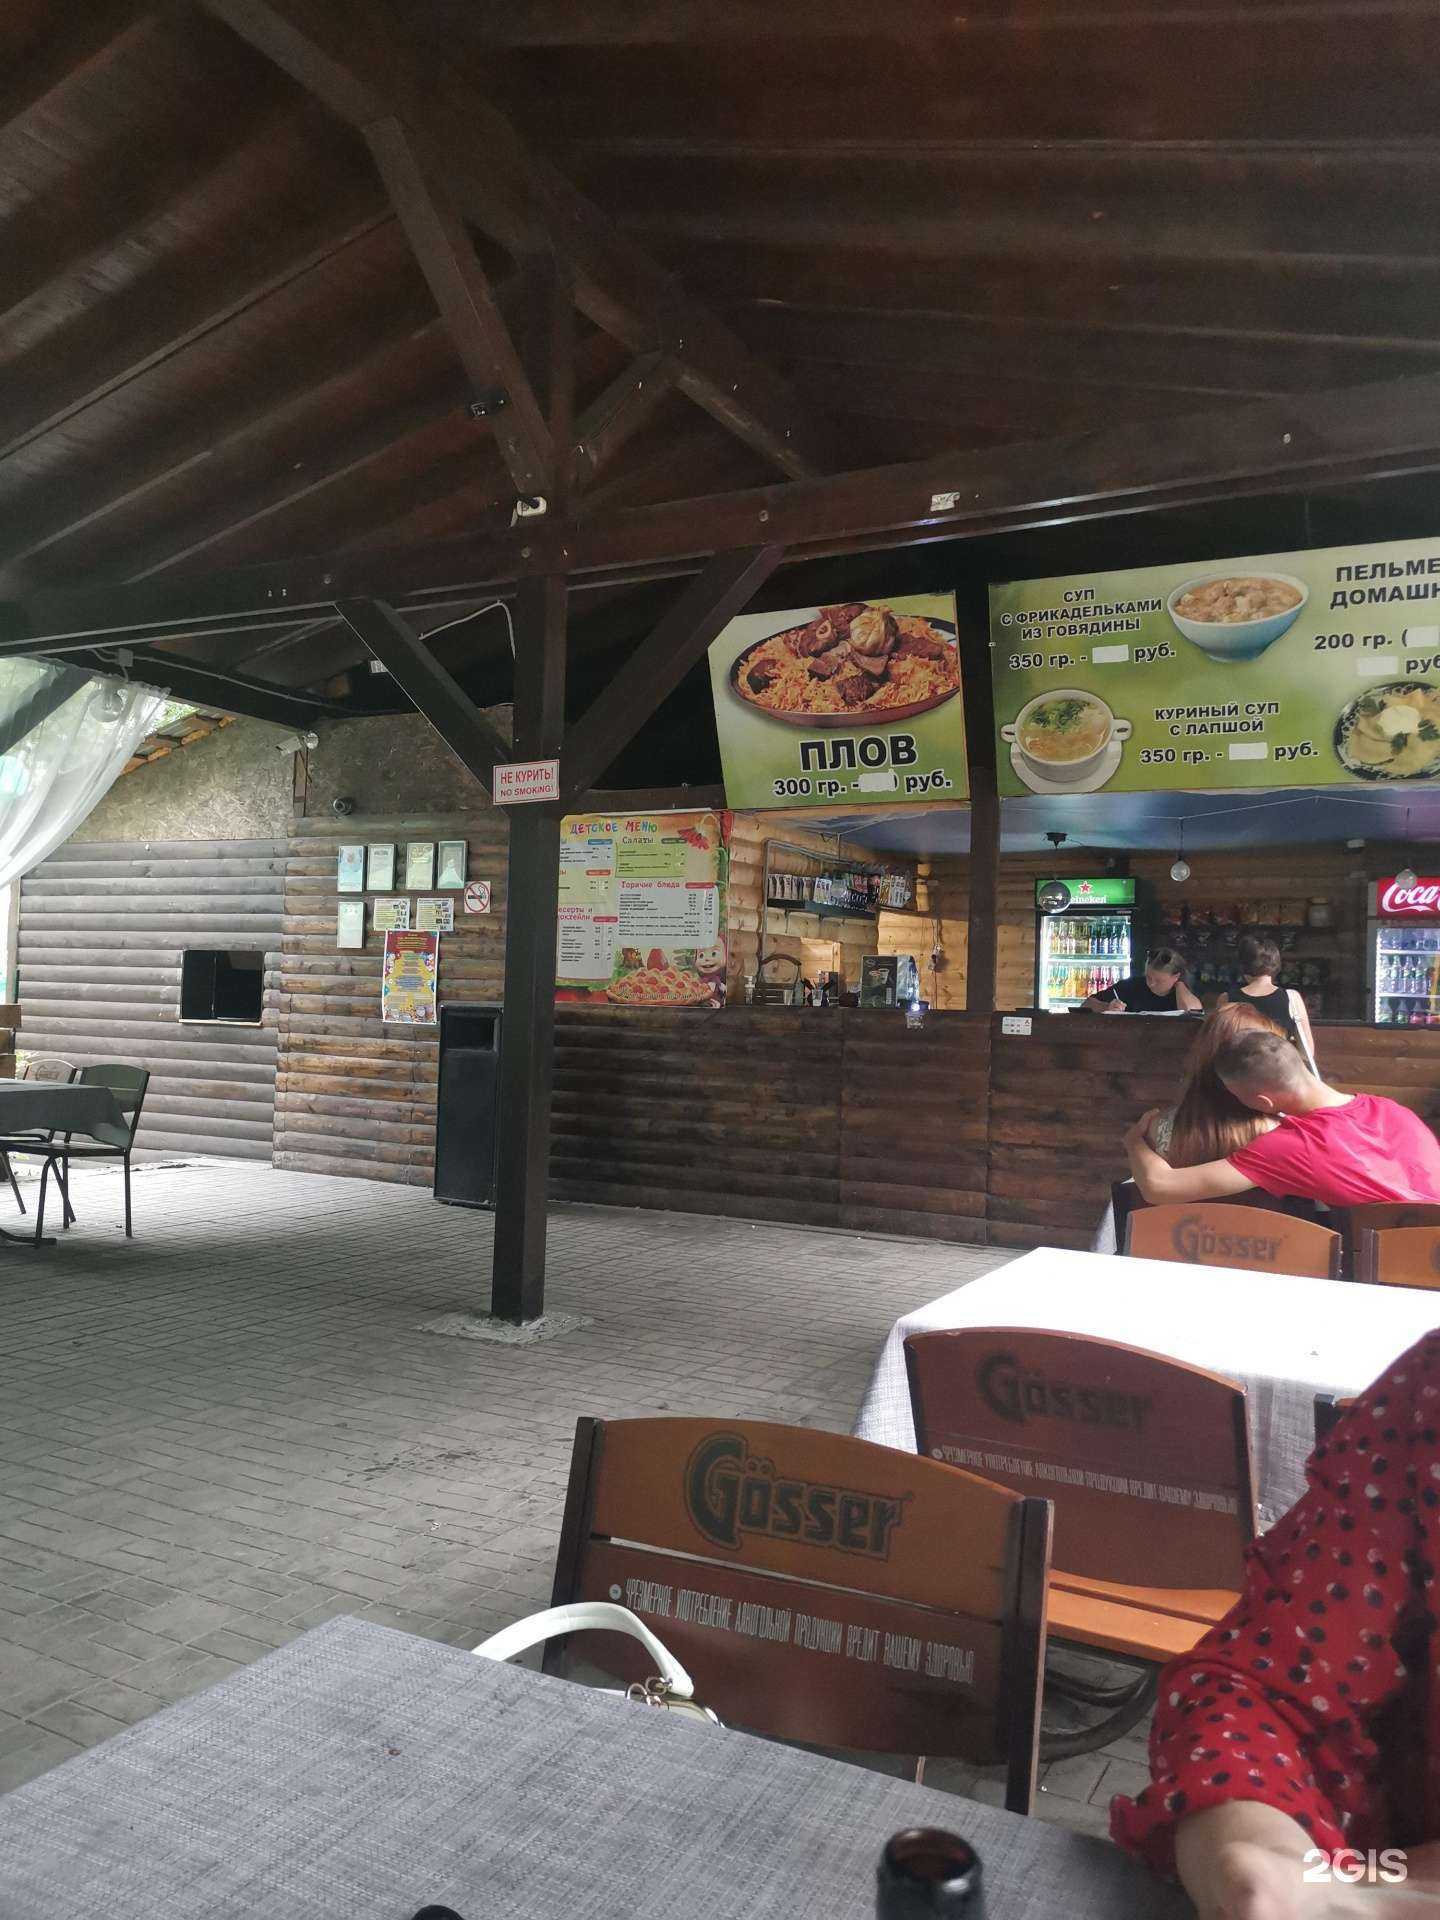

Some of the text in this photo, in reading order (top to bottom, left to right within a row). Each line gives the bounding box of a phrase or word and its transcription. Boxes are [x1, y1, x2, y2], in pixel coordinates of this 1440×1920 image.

[1064, 589, 1095, 603] СУП
[1002, 599, 1162, 626] С ФРИКАДЕЛЬКАМИ
[1022, 618, 1140, 640] ИЗ ГОВЯДИНЫ
[1315, 633, 1354, 650] 200
[1363, 632, 1392, 649] гр.
[1010, 653, 1043, 668] 350
[1049, 654, 1074, 669] гр.
[1134, 643, 1175, 663] руб.
[1155, 701, 1279, 721] КУРИНЫЙ СУП
[1170, 718, 1264, 735] С ЛАПШОЙ
[800, 735, 917, 771] ПЛОВ
[1140, 749, 1175, 763] 350
[1183, 749, 1210, 765] гр.
[1274, 742, 1318, 760] руб.
[501, 771, 513, 784] НЕ
[774, 779, 810, 796] 300
[817, 779, 846, 797] гр.
[905, 770, 951, 792] руб.
[501, 788, 512, 797] NO
[570, 822, 618, 835] ДЕТСКОЕ
[622, 836, 654, 844] Салаты
[1070, 895, 1107, 904] eineken
[685, 1431, 911, 1561] Gösser
[626, 1576, 673, 1617] ЧРЕЗМЕРНОЕ
